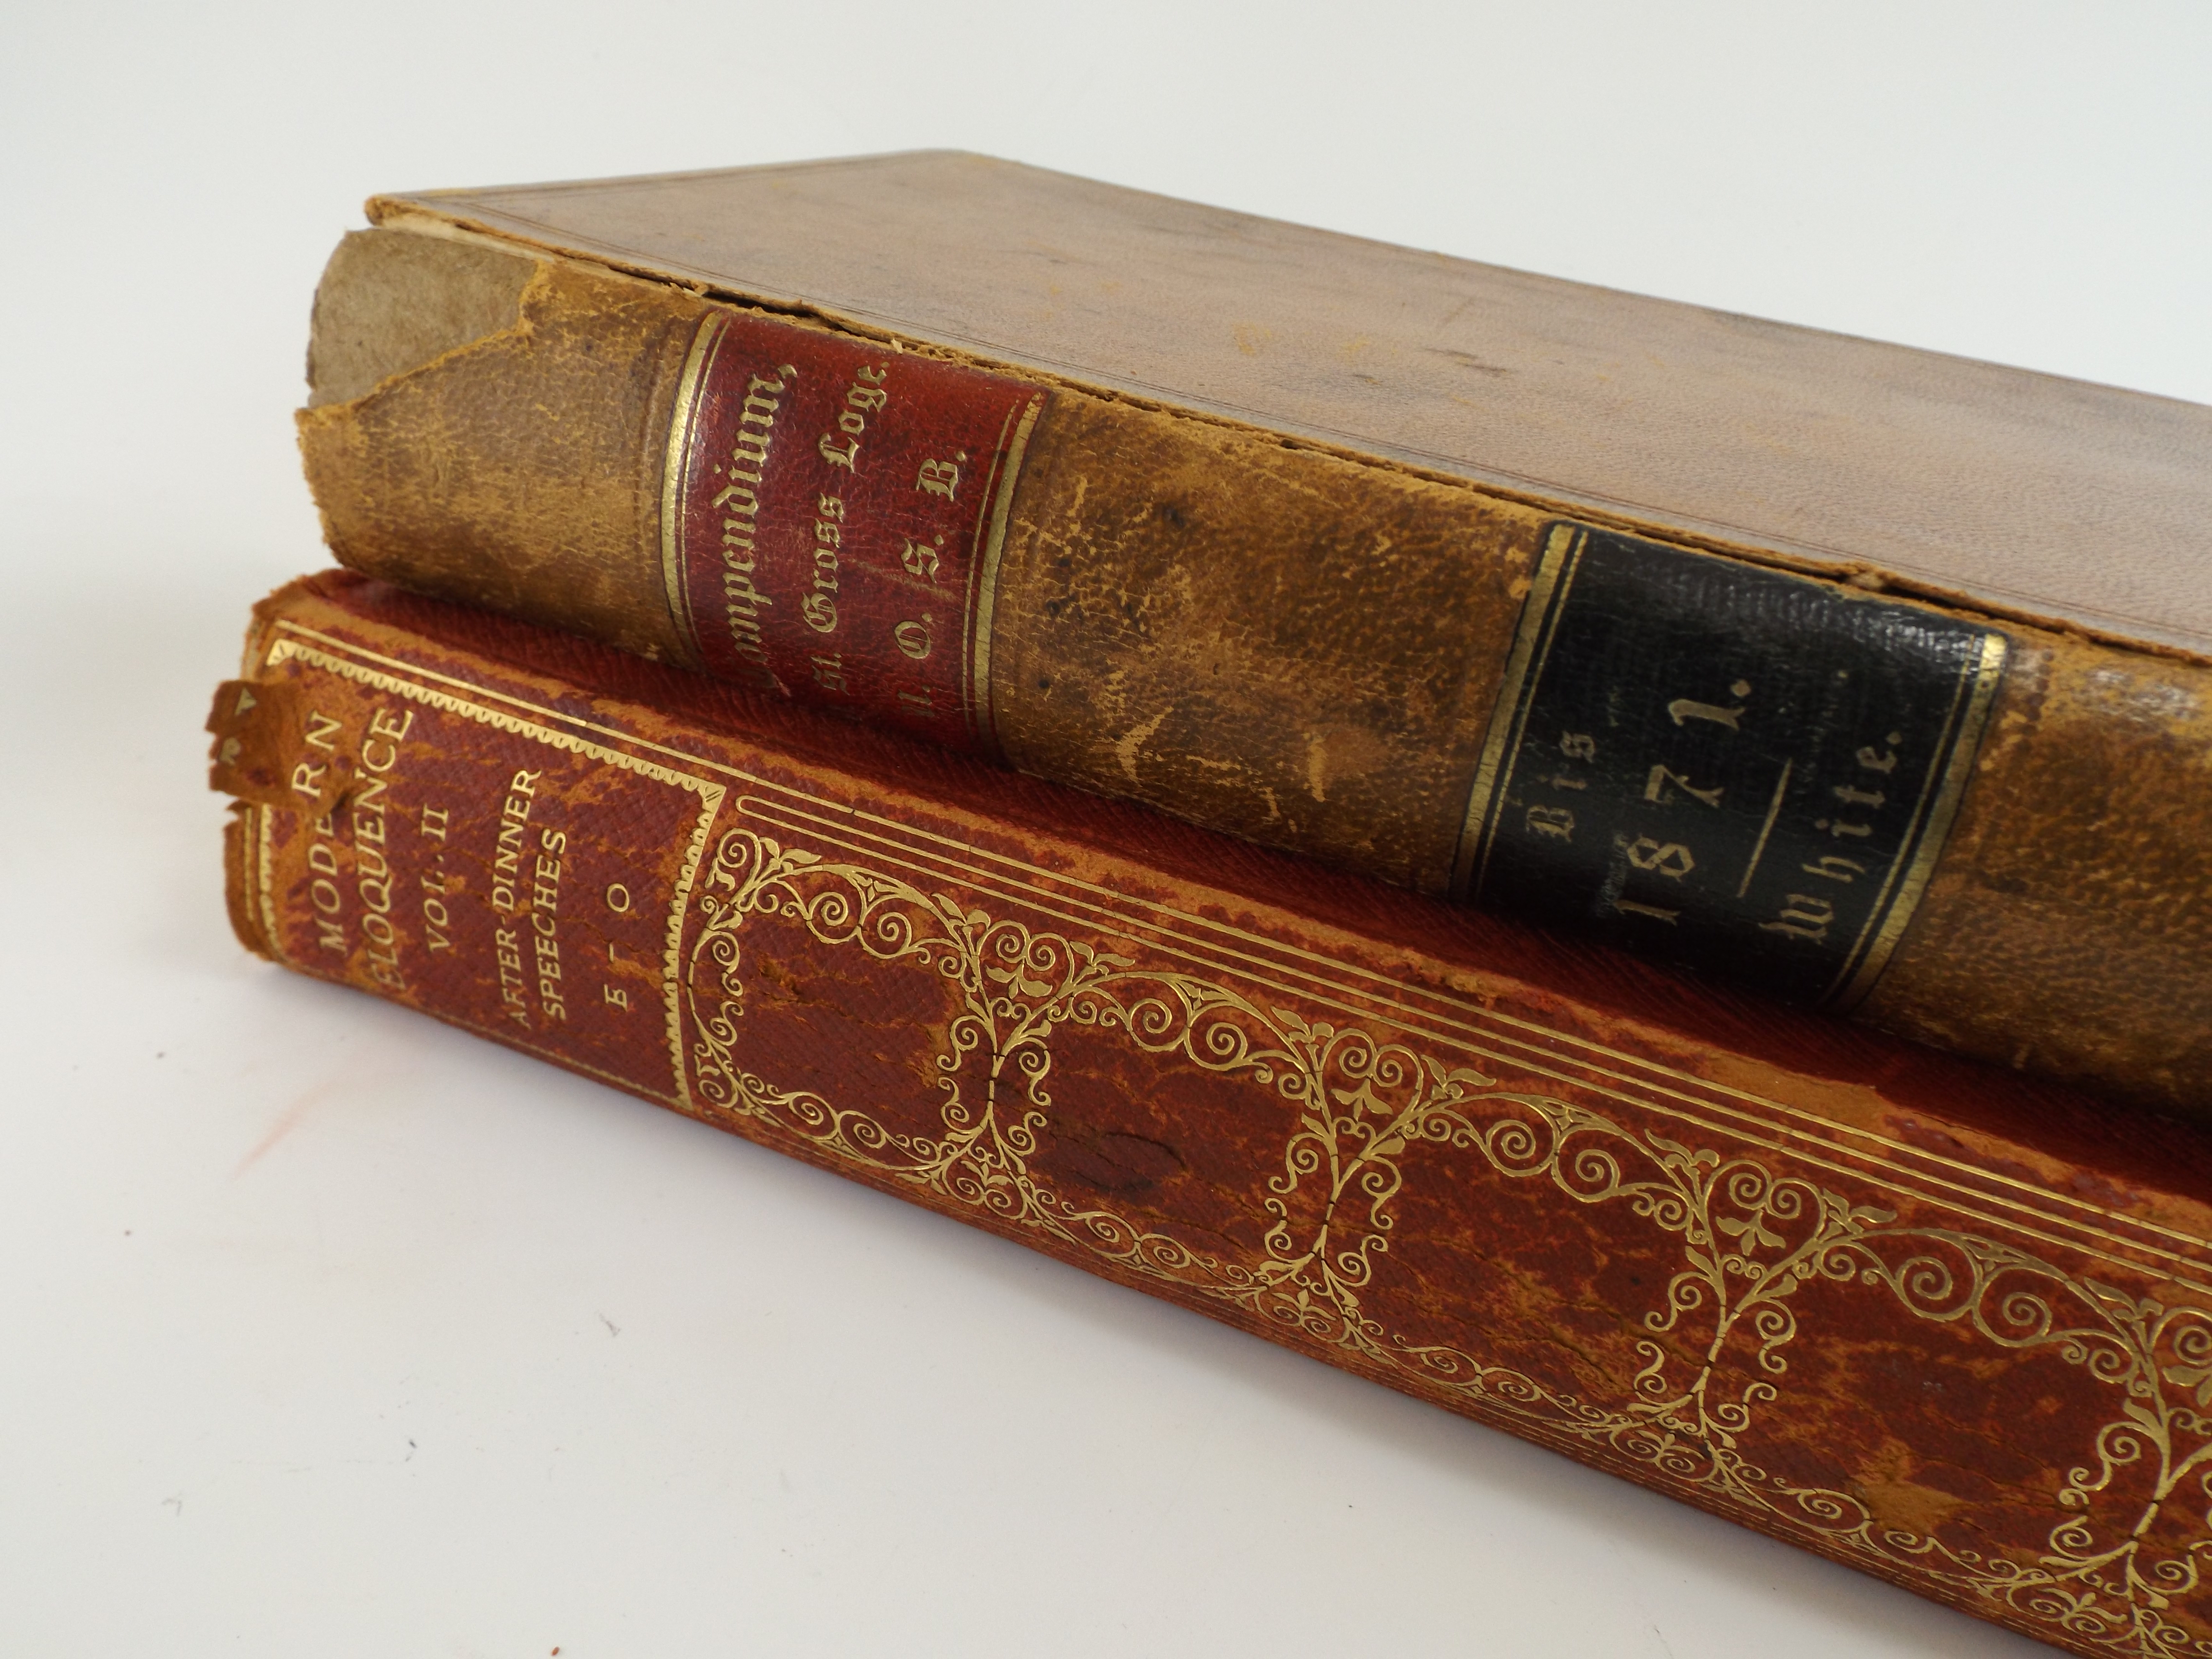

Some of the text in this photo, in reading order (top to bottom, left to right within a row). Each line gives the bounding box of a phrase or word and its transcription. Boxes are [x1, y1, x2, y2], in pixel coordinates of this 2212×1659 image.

[818, 361, 890, 473] Loge.
[916, 451, 967, 501] B.
[801, 492, 844, 633] Gross
[901, 534, 944, 583] S.
[894, 613, 933, 660] O.
[422, 804, 449, 842] II
[1525, 731, 1595, 842] Bis
[1615, 679, 1751, 925] 1871.
[1758, 731, 1902, 944] White.
[353, 708, 413, 990] ELOQUENCE
[606, 883, 631, 912] O
[533, 830, 567, 1021] SPEECHES
[604, 984, 628, 1010] E
